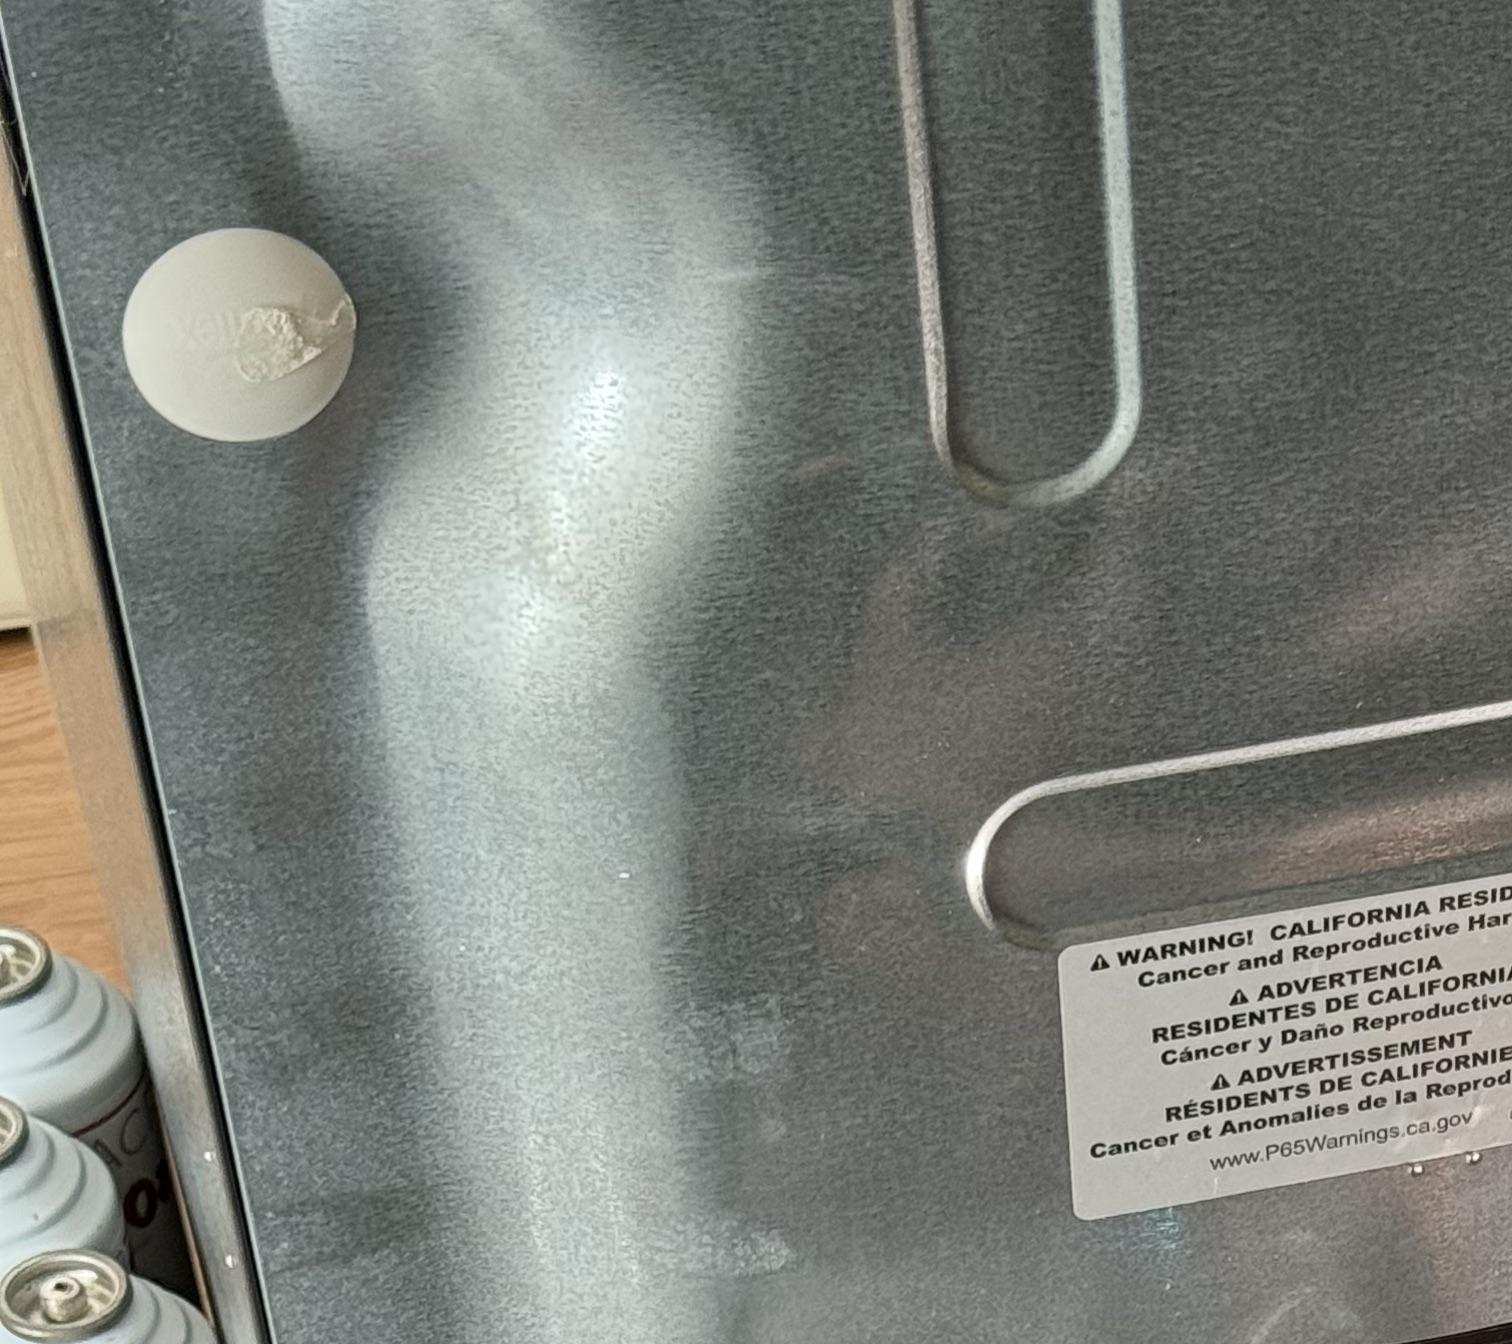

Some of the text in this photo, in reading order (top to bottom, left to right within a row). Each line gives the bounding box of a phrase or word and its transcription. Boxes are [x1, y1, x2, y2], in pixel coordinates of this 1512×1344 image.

[1116, 929, 1254, 967] WARNING!
[1269, 900, 1432, 942] CALIFORNIA
[1137, 960, 1231, 988] Cancer
[1236, 948, 1284, 972] and
[1292, 922, 1460, 963] Reproductive
[1256, 954, 1444, 1003] ADVERTENCIA
[1151, 1000, 1317, 1044] RESIDENTES
[1324, 992, 1360, 1014] DE
[1160, 1039, 1253, 1066] Cáncer
[1257, 1035, 1273, 1054] y
[1280, 1022, 1345, 1047] Daño
[1237, 1029, 1473, 1087] ADVERTISSEMENT
[1089, 1132, 1180, 1159] Cancer
[1186, 1123, 1213, 1143] et
[1218, 1102, 1350, 1137] Anomalies
[1357, 1094, 1388, 1112] de
[1395, 1088, 1418, 1106] la
[1164, 1082, 1312, 1123] RÉSIDENTS
[1319, 1074, 1353, 1096] DE
[1209, 1111, 1473, 1171] www.P65Warnings.ca.gov
